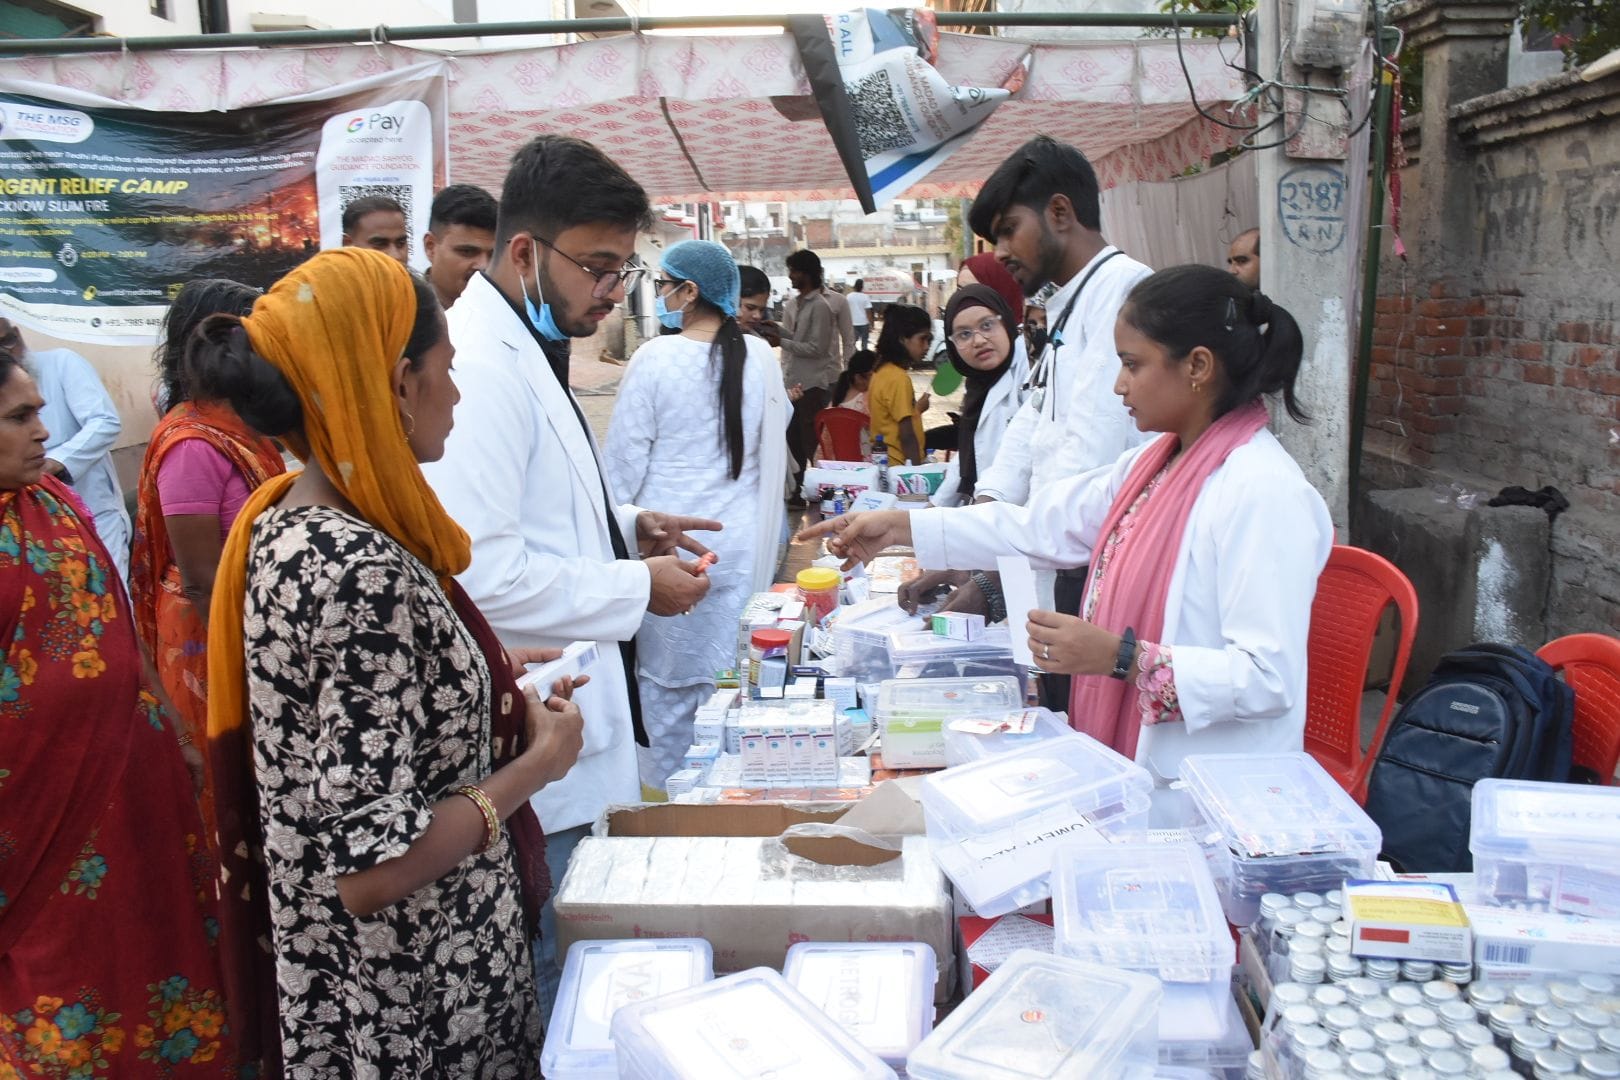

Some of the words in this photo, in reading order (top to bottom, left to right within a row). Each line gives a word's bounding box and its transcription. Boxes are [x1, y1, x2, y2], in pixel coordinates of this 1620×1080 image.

[840, 28, 852, 57] ALL
[17, 112, 44, 123] THE
[47, 115, 81, 126] MSG
[369, 113, 404, 134] Pay
[60, 178, 119, 195] RELIEF
[121, 180, 189, 195] CAMP
[48, 200, 85, 212] SLUM
[86, 200, 110, 212] FIRE
